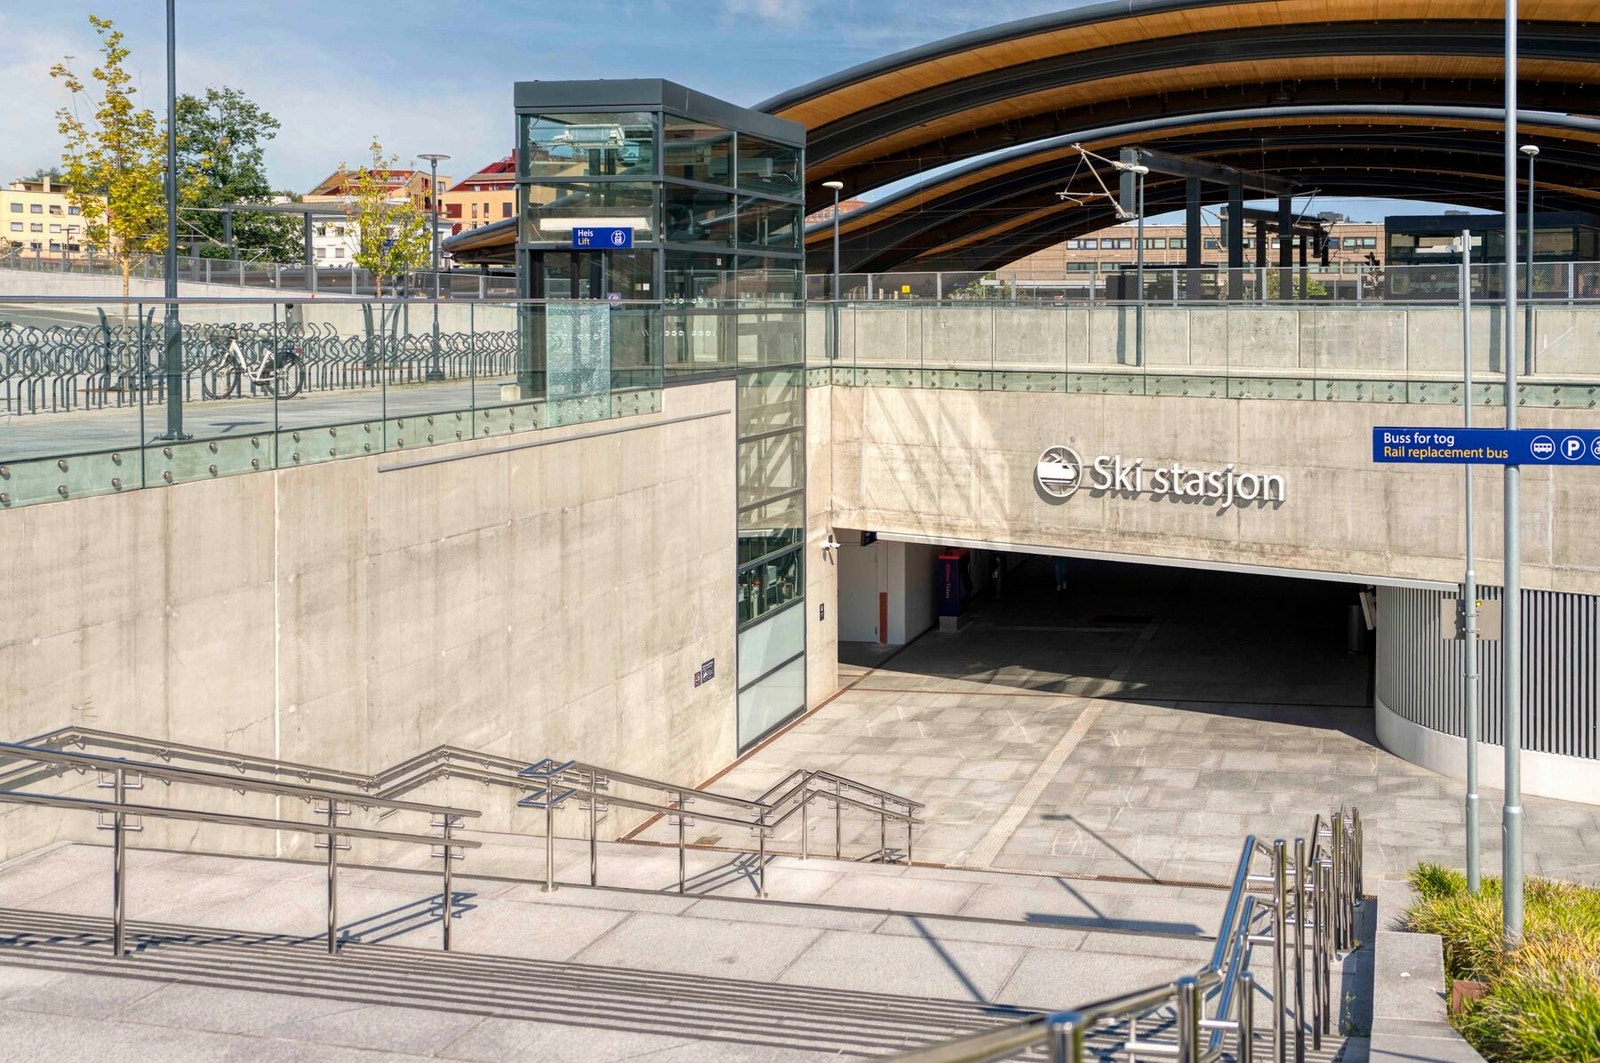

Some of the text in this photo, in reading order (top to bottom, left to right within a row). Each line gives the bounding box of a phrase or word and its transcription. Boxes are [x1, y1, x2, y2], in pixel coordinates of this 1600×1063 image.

[577, 229, 594, 237] Heis
[577, 237, 590, 245] Lift
[1384, 432, 1455, 447] Buss for tog
[1384, 446, 1509, 460] Rail replacement bus
[1567, 440, 1580, 456] P
[1093, 454, 1286, 508] Ski stasjon
